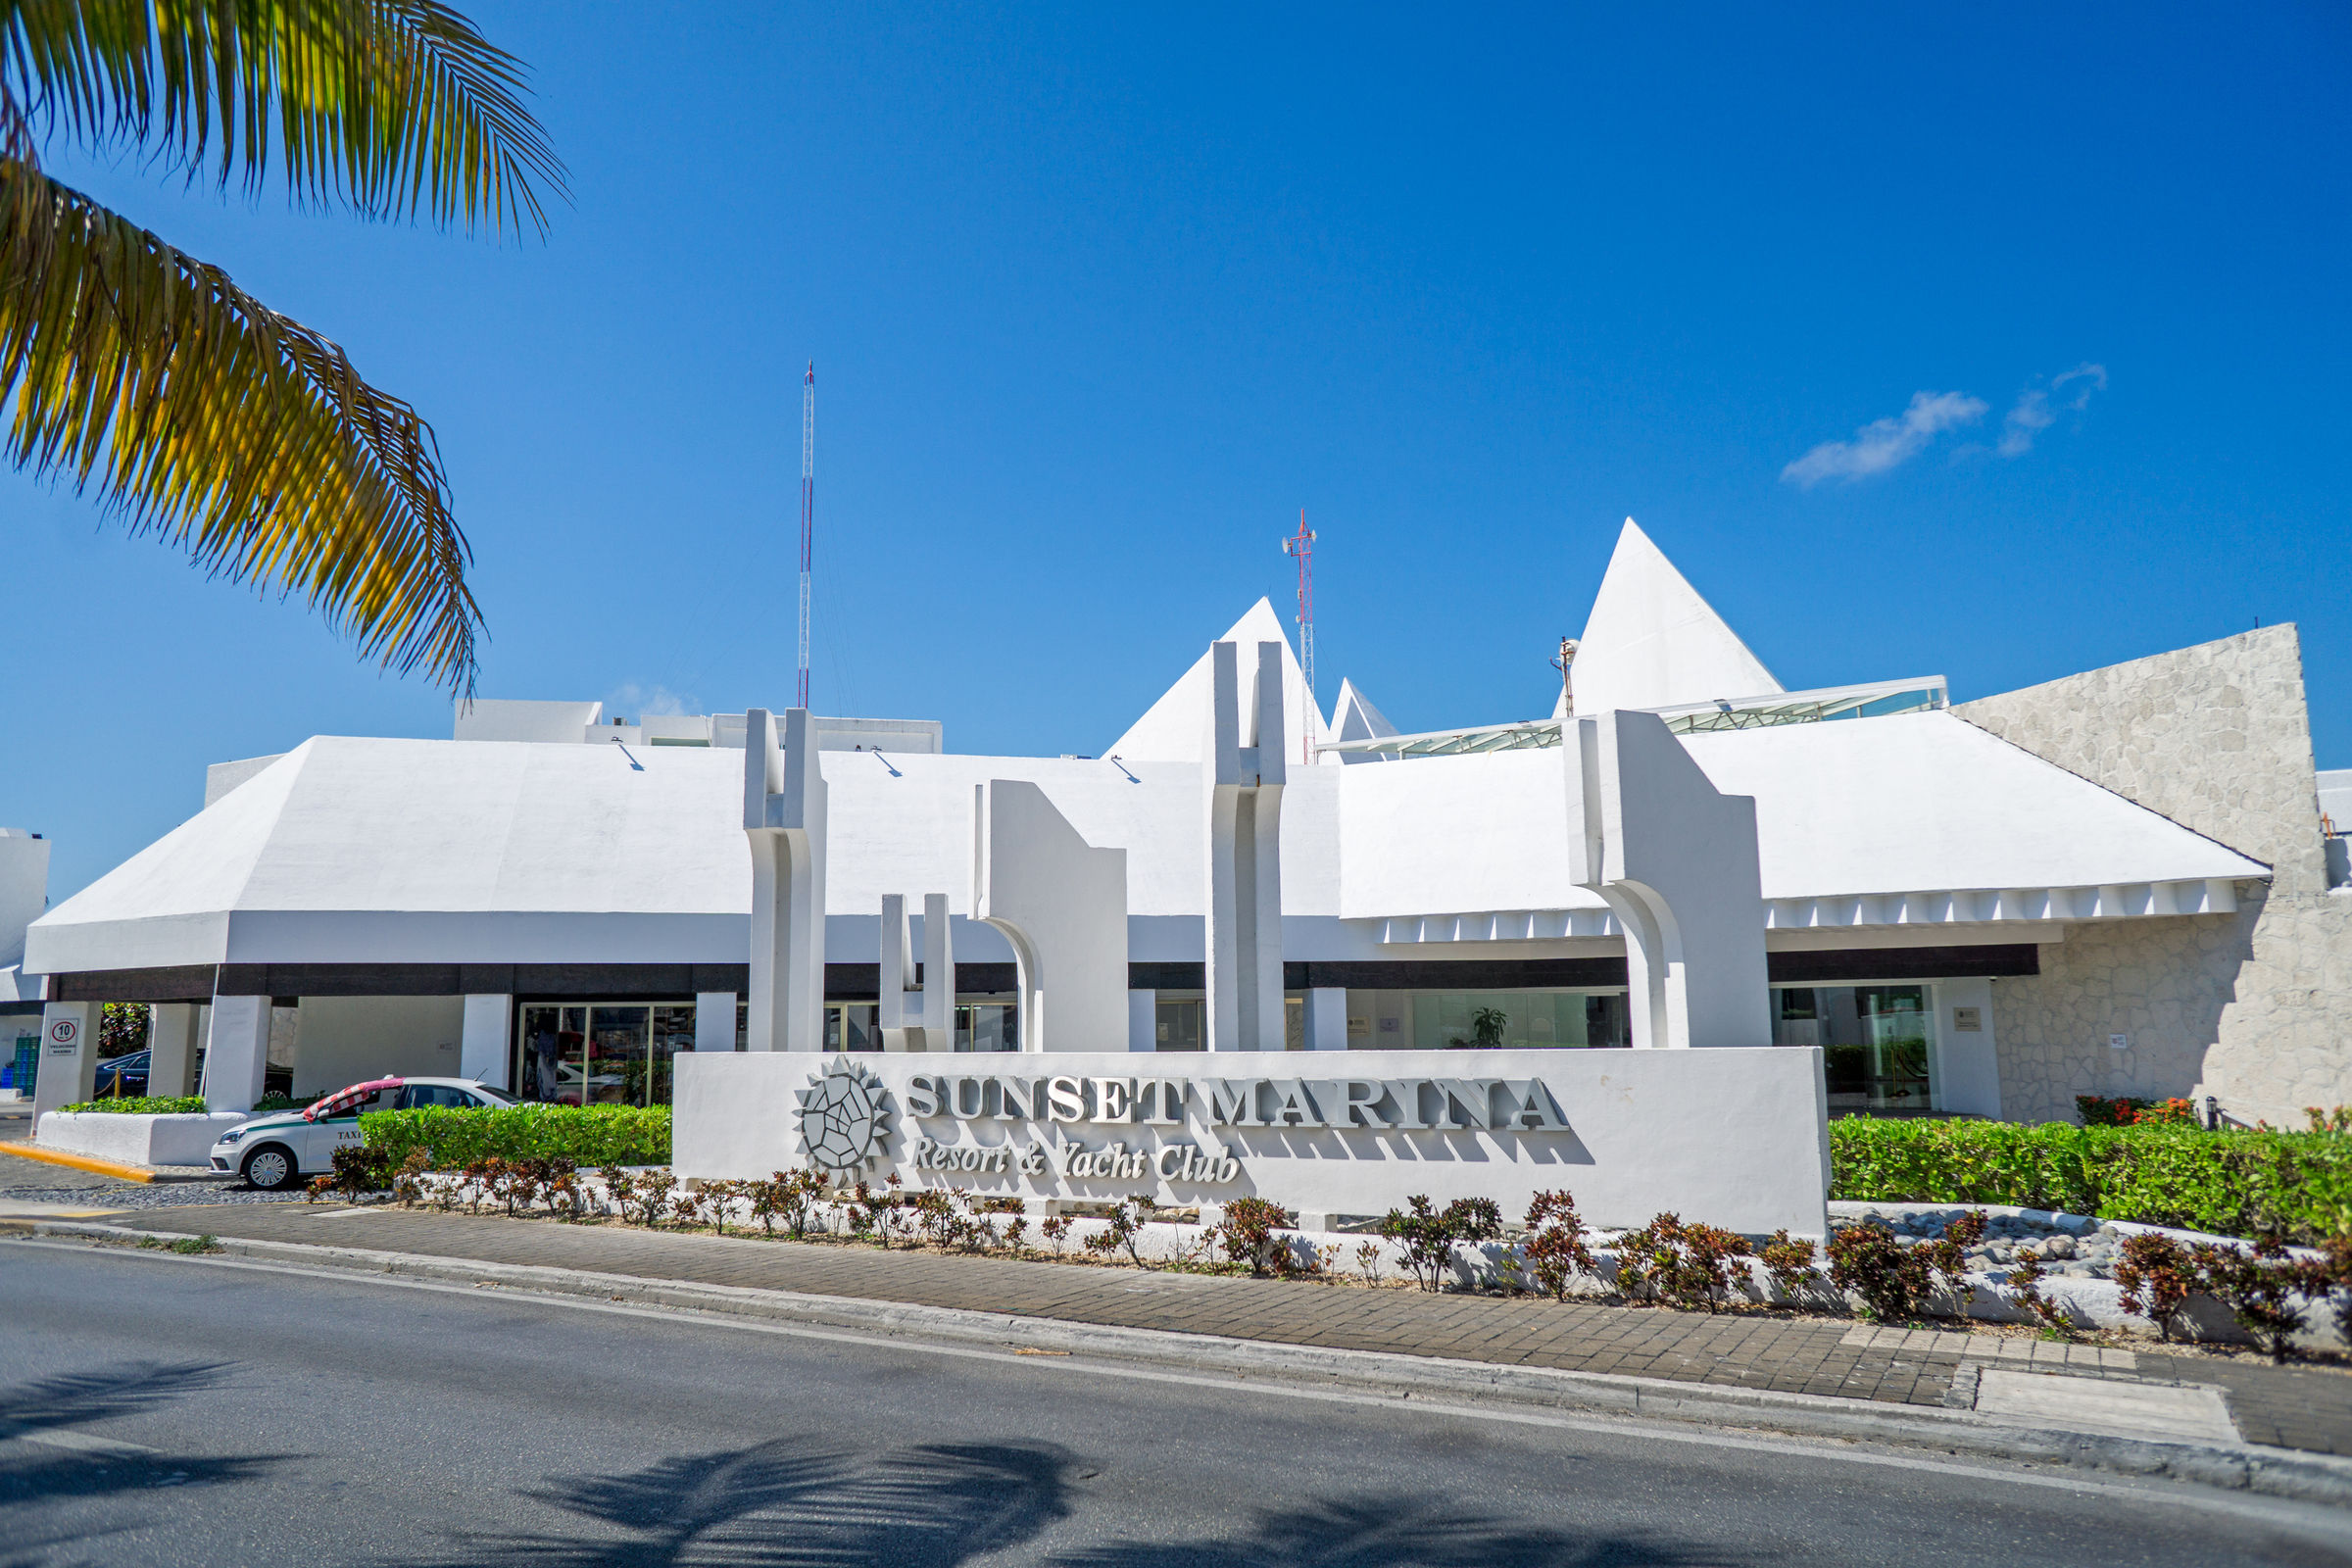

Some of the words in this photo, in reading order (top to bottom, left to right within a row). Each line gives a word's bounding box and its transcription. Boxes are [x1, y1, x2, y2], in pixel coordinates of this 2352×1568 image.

[59, 1024, 71, 1036] 10
[906, 1074, 1187, 1125] SUNSET
[1200, 1077, 1569, 1131] MARINA
[337, 1130, 362, 1140] TAXI
[909, 1136, 1010, 1173] Resort
[1015, 1140, 1046, 1176] &
[1059, 1142, 1148, 1179] Yacht
[1154, 1144, 1242, 1184] Club
